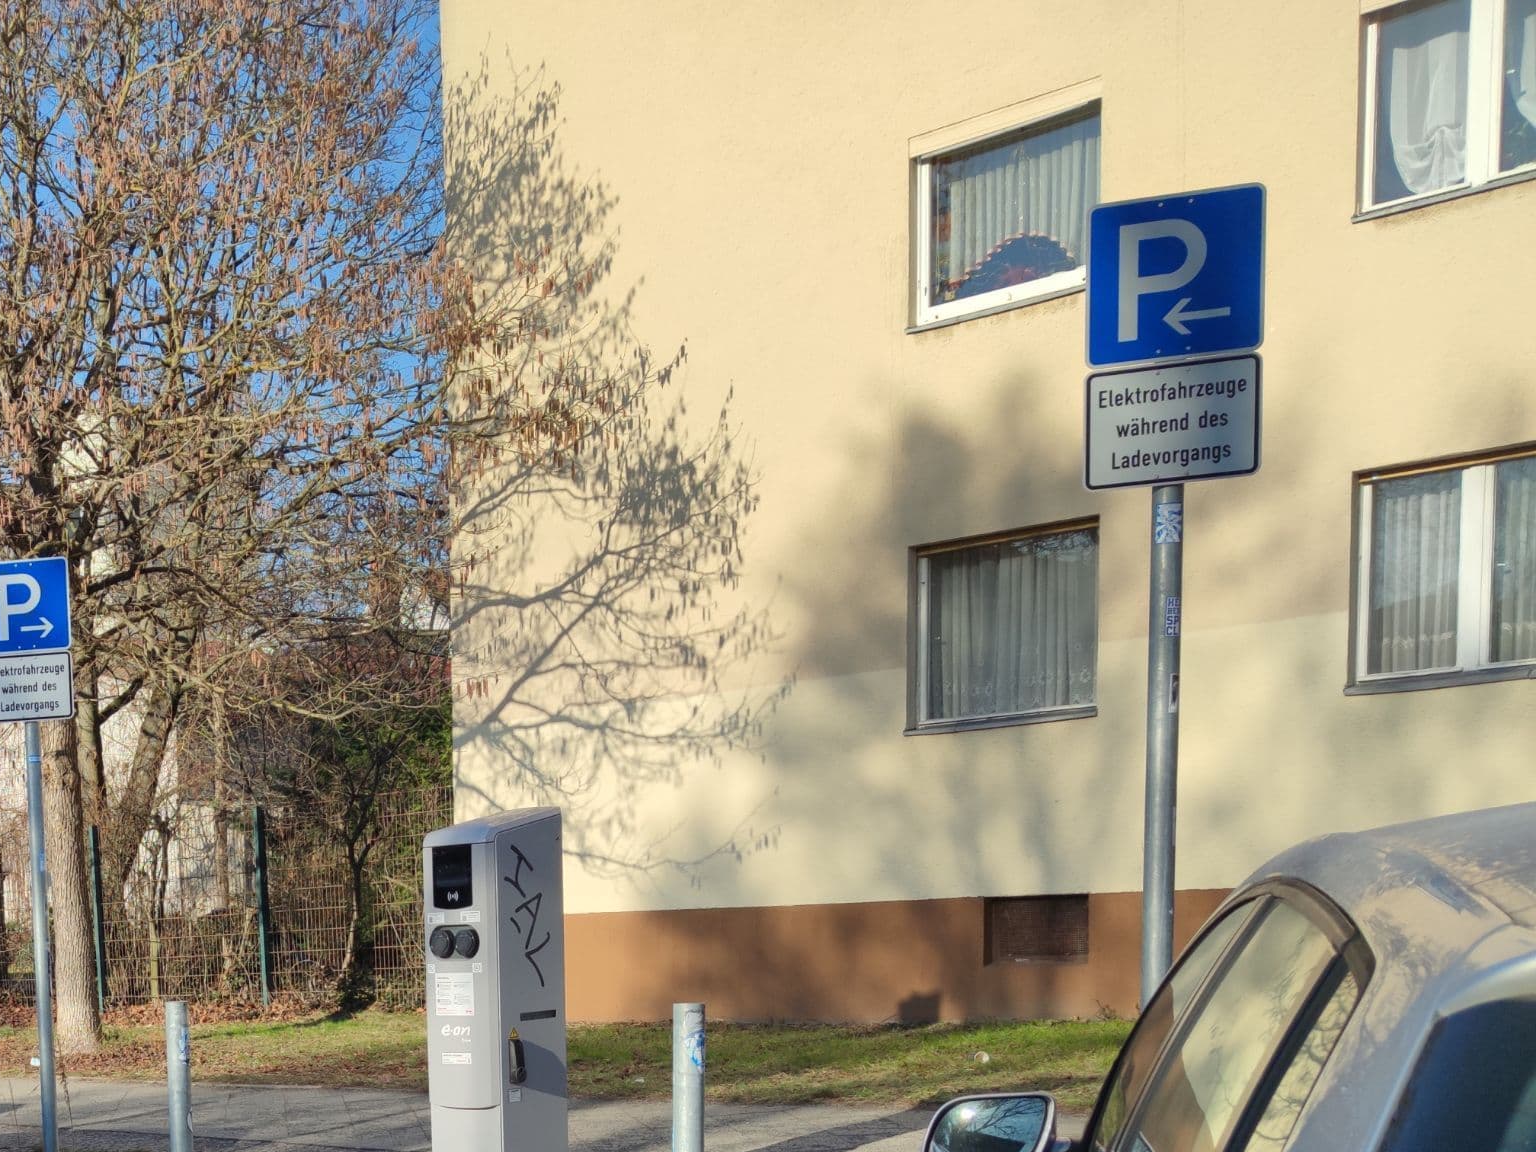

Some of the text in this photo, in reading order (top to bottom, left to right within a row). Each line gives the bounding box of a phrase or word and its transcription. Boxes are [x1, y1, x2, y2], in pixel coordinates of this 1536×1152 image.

[1117, 218, 1208, 343] P
[1098, 378, 1247, 408] Elektrofahrzeuge
[1116, 410, 1229, 438] während des
[1112, 444, 1232, 470] Ladevorgangs
[1, 681, 57, 694] während des
[0, 700, 60, 712] Ladevorgangs
